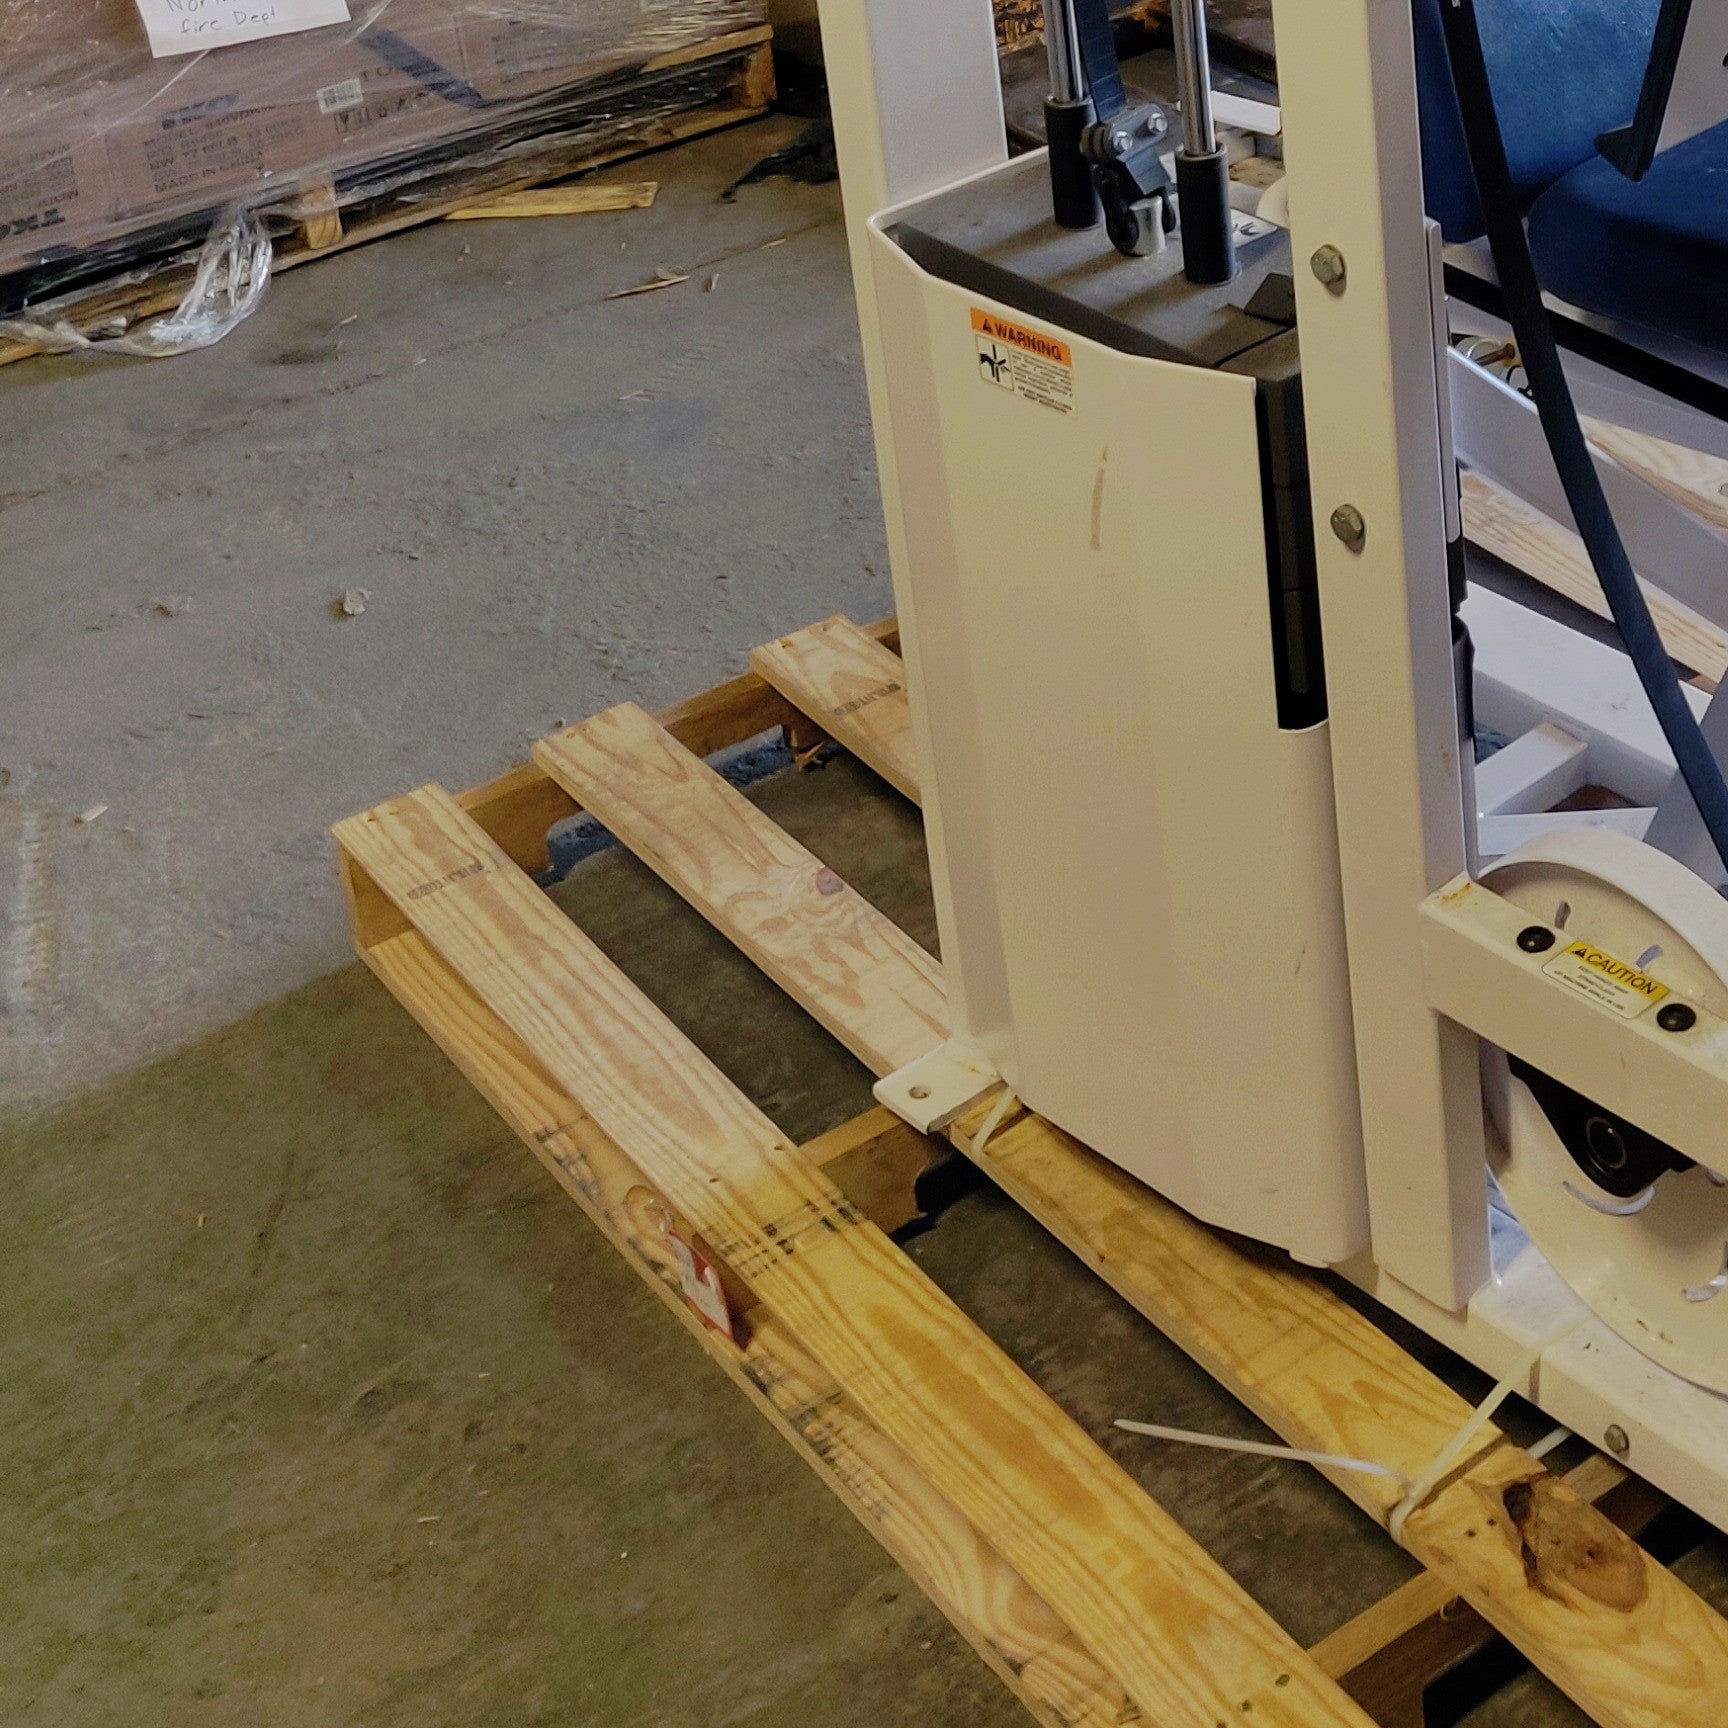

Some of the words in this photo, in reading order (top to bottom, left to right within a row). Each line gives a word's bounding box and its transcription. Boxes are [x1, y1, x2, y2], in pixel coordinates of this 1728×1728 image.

[233, 6, 277, 26] Dept
[995, 323, 1062, 361] WARNING
[1586, 953, 1658, 995] CAUTION
